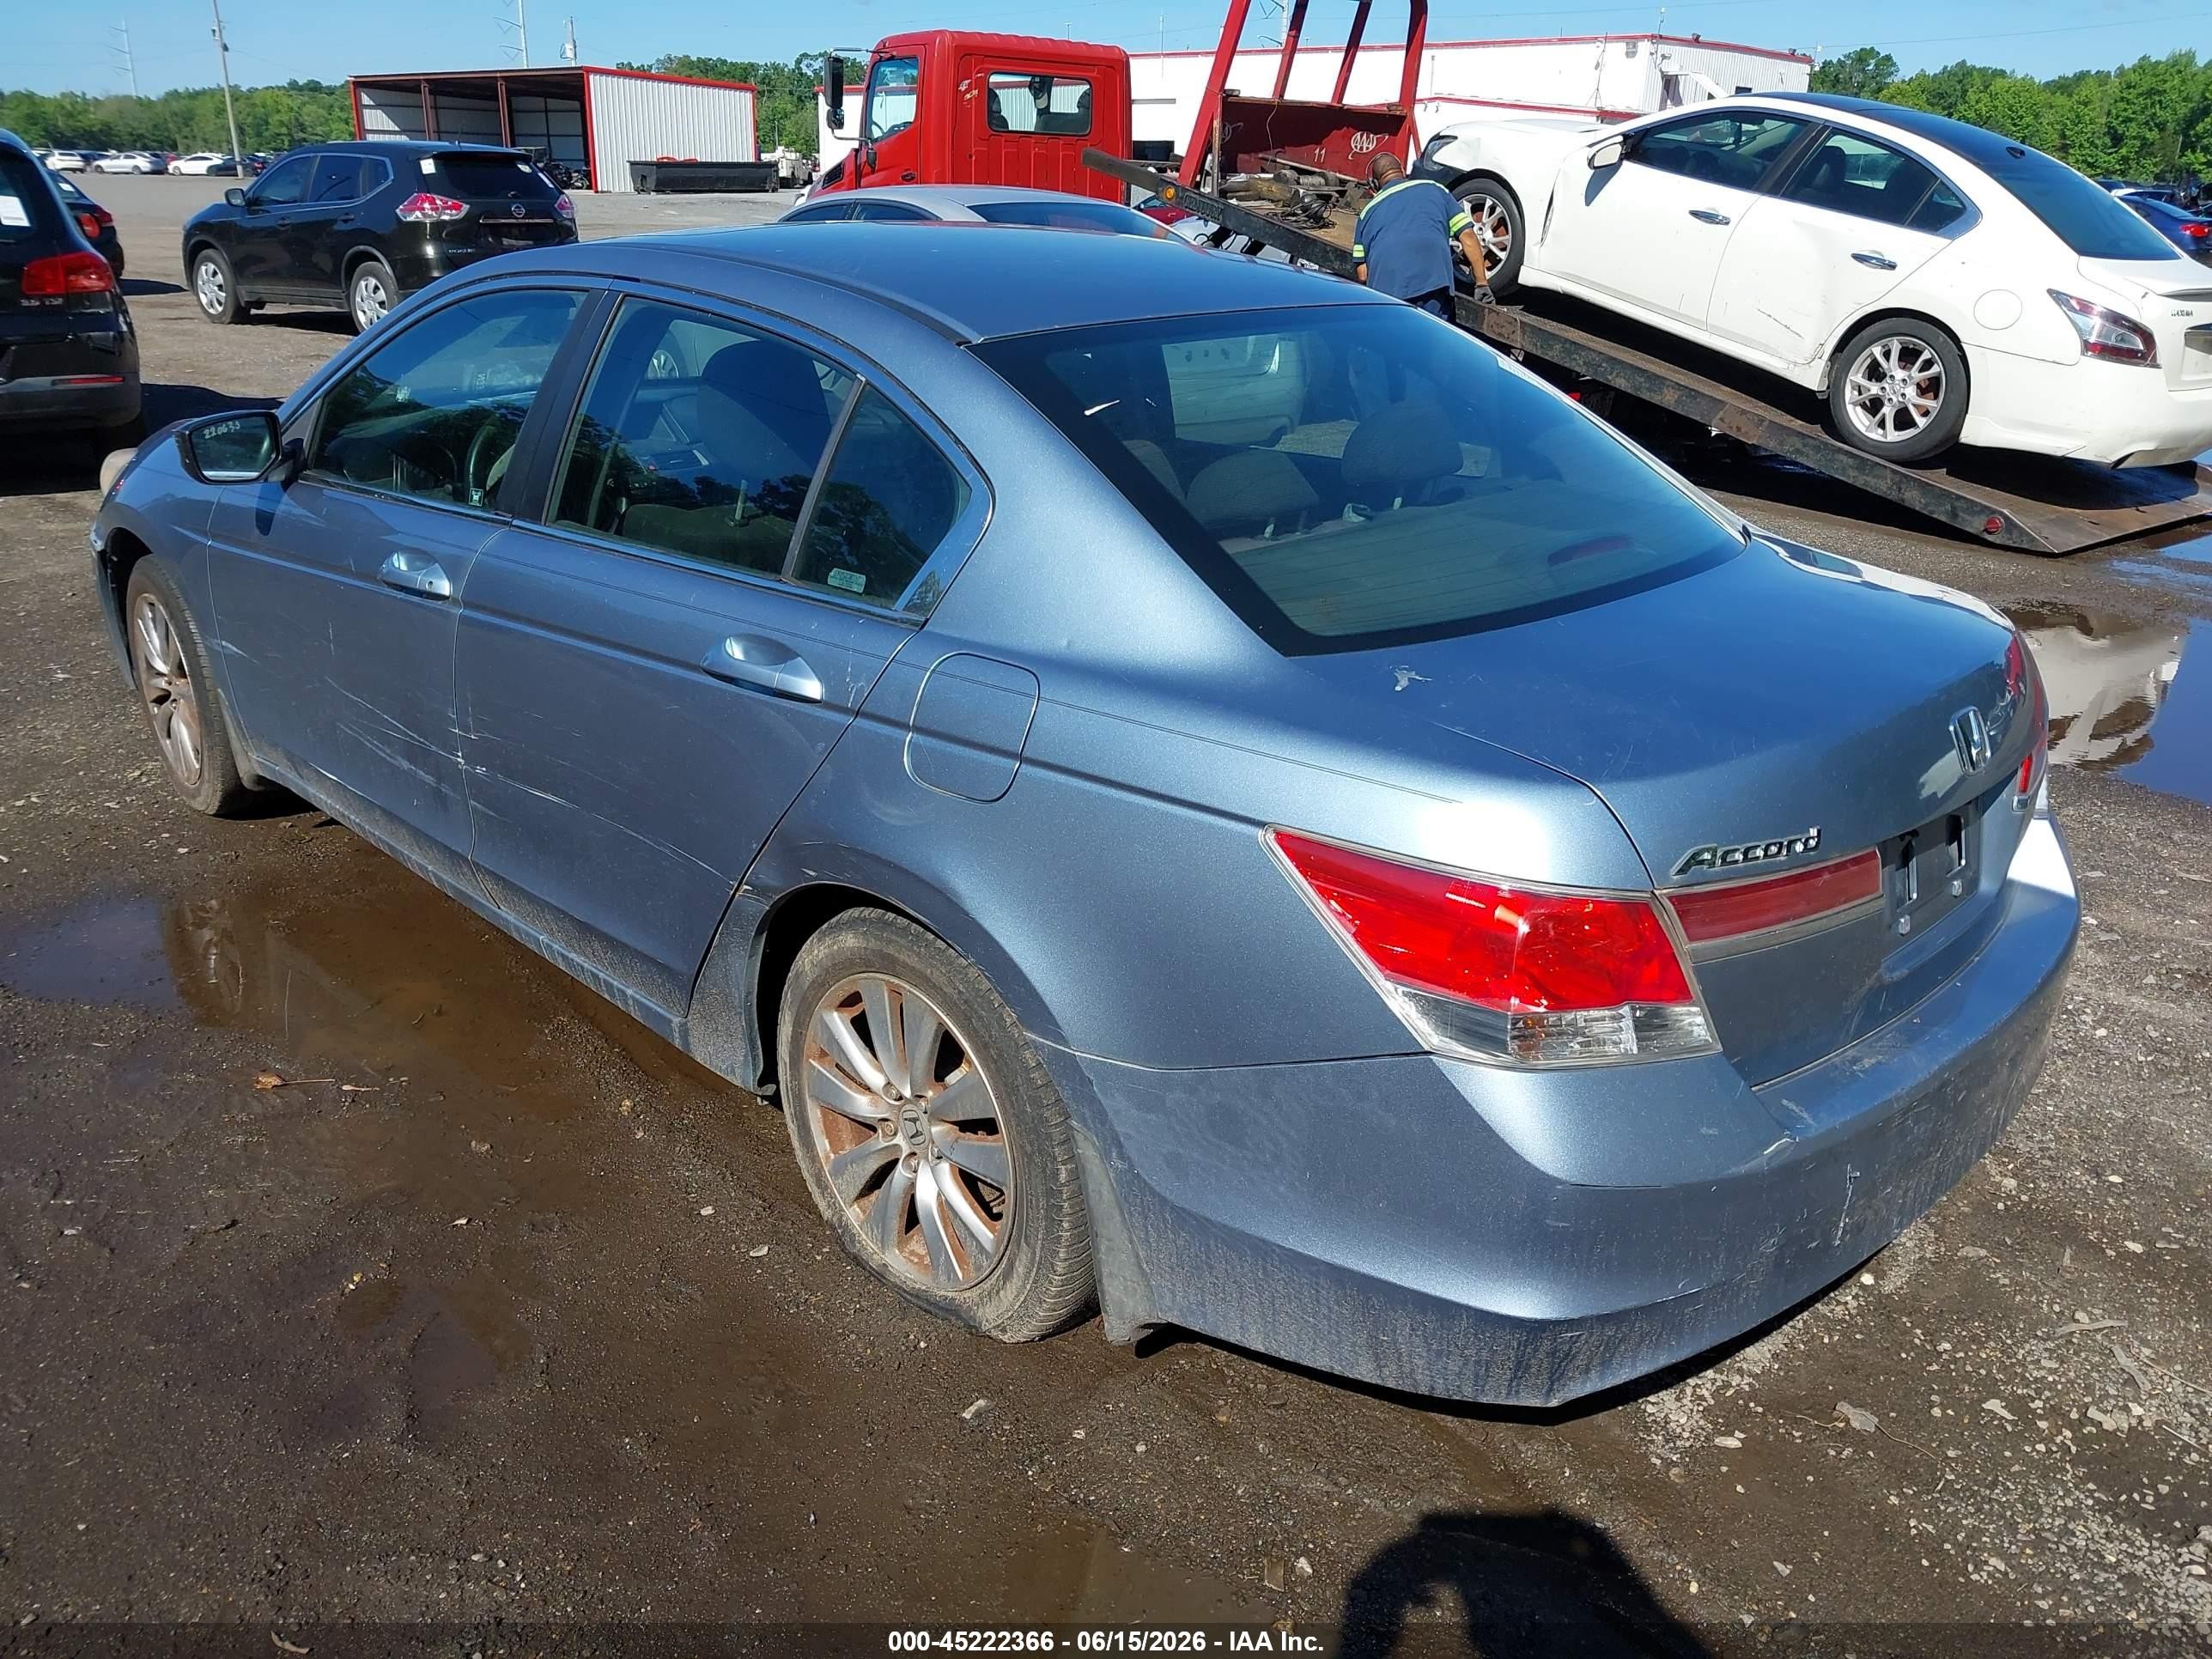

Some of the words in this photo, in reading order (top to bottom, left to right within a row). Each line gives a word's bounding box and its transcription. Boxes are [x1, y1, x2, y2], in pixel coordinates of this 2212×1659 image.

[1351, 131, 1377, 154] AAA
[1313, 147, 1327, 164] 11
[1670, 826, 1821, 876] Accord
